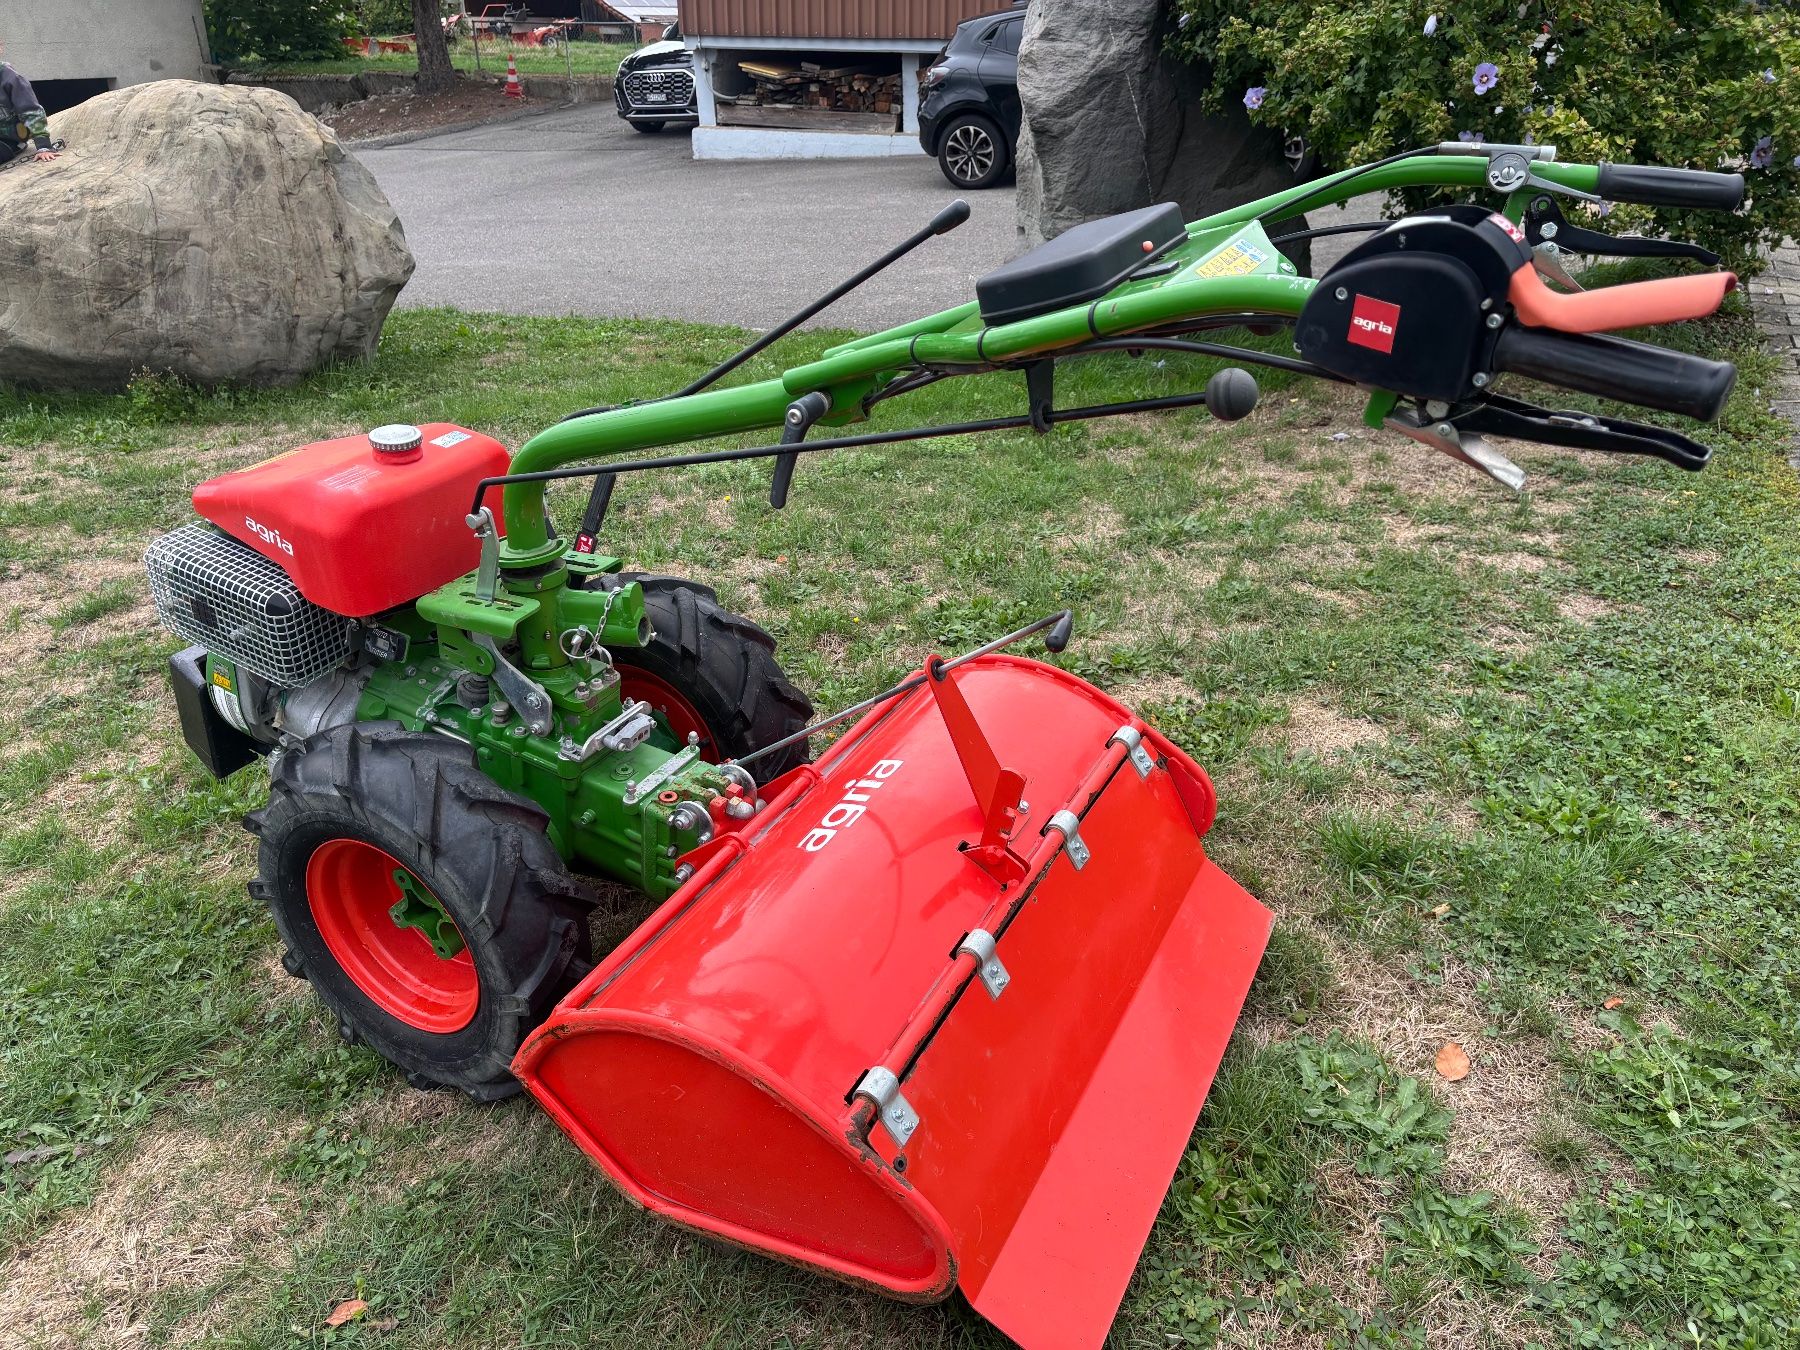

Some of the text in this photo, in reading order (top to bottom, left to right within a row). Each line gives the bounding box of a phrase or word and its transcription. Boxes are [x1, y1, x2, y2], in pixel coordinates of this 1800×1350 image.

[1353, 316, 1392, 335] agria
[245, 515, 294, 556] agria
[796, 759, 904, 853] agria
